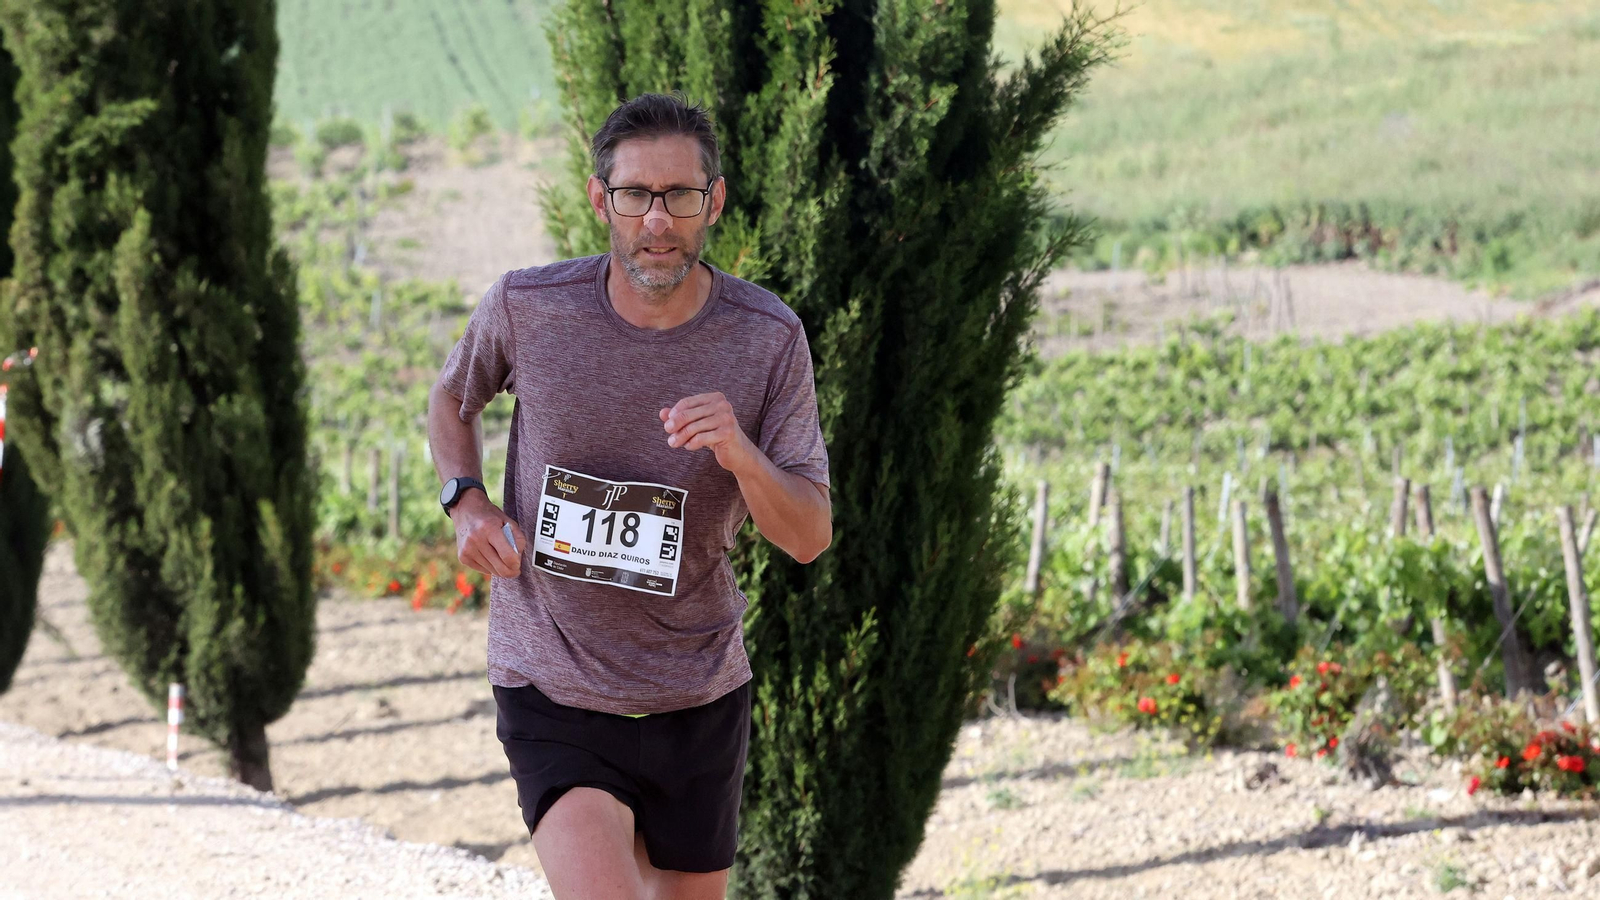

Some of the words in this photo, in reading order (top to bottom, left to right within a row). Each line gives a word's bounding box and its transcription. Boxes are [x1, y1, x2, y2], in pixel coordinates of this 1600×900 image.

[581, 508, 641, 548] 118
[571, 546, 597, 557] DAVID
[598, 551, 619, 559] DIAZ
[620, 553, 651, 566] QUIROS
